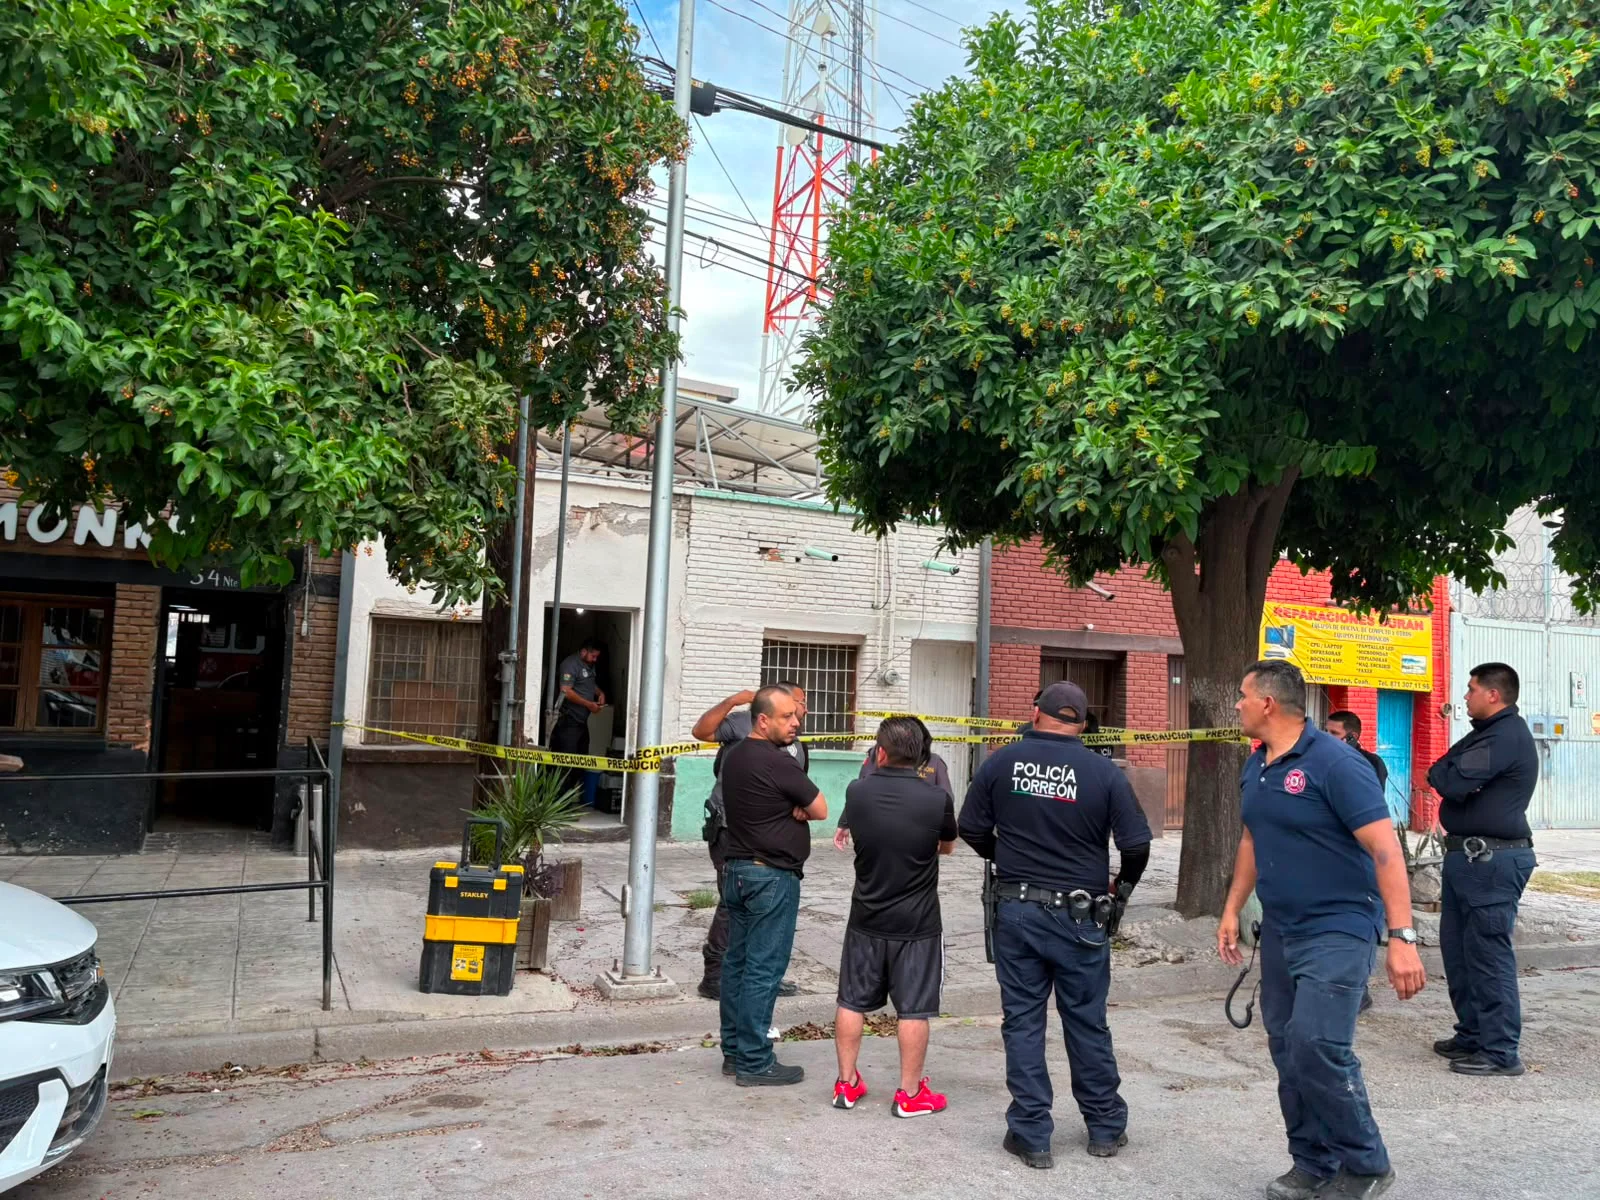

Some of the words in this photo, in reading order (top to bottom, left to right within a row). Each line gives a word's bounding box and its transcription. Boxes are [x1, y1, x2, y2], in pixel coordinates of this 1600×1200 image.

[223, 576, 238, 587] Nte
[1273, 606, 1375, 627] REPARACIONES
[1311, 622, 1332, 631] EQUIPOS
[1334, 632, 1354, 640] EQUIPOS
[636, 743, 700, 760] ECAUCIÓN
[1013, 762, 1077, 783] POLICÍA
[1012, 777, 1077, 800] TORREÓN
[460, 891, 489, 899] STANLEY
